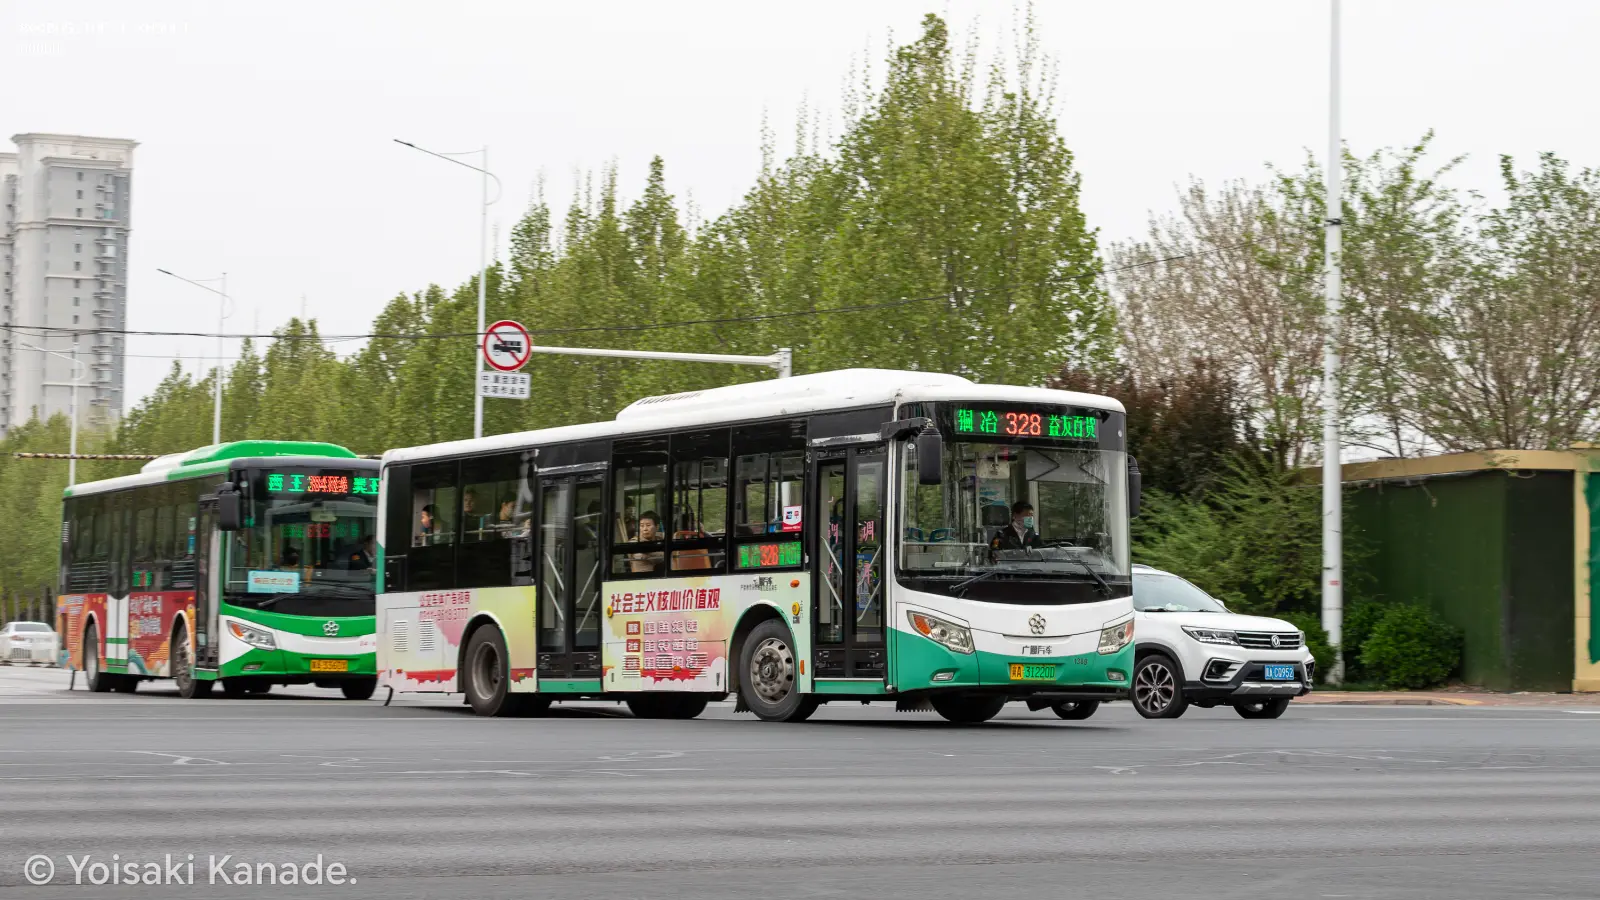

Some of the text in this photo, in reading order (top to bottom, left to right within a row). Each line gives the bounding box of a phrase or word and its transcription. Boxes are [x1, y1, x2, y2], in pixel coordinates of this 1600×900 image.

[1006, 412, 1041, 436] 328
[759, 544, 779, 566] 328
[611, 588, 721, 613] 社会主义核心价值观
